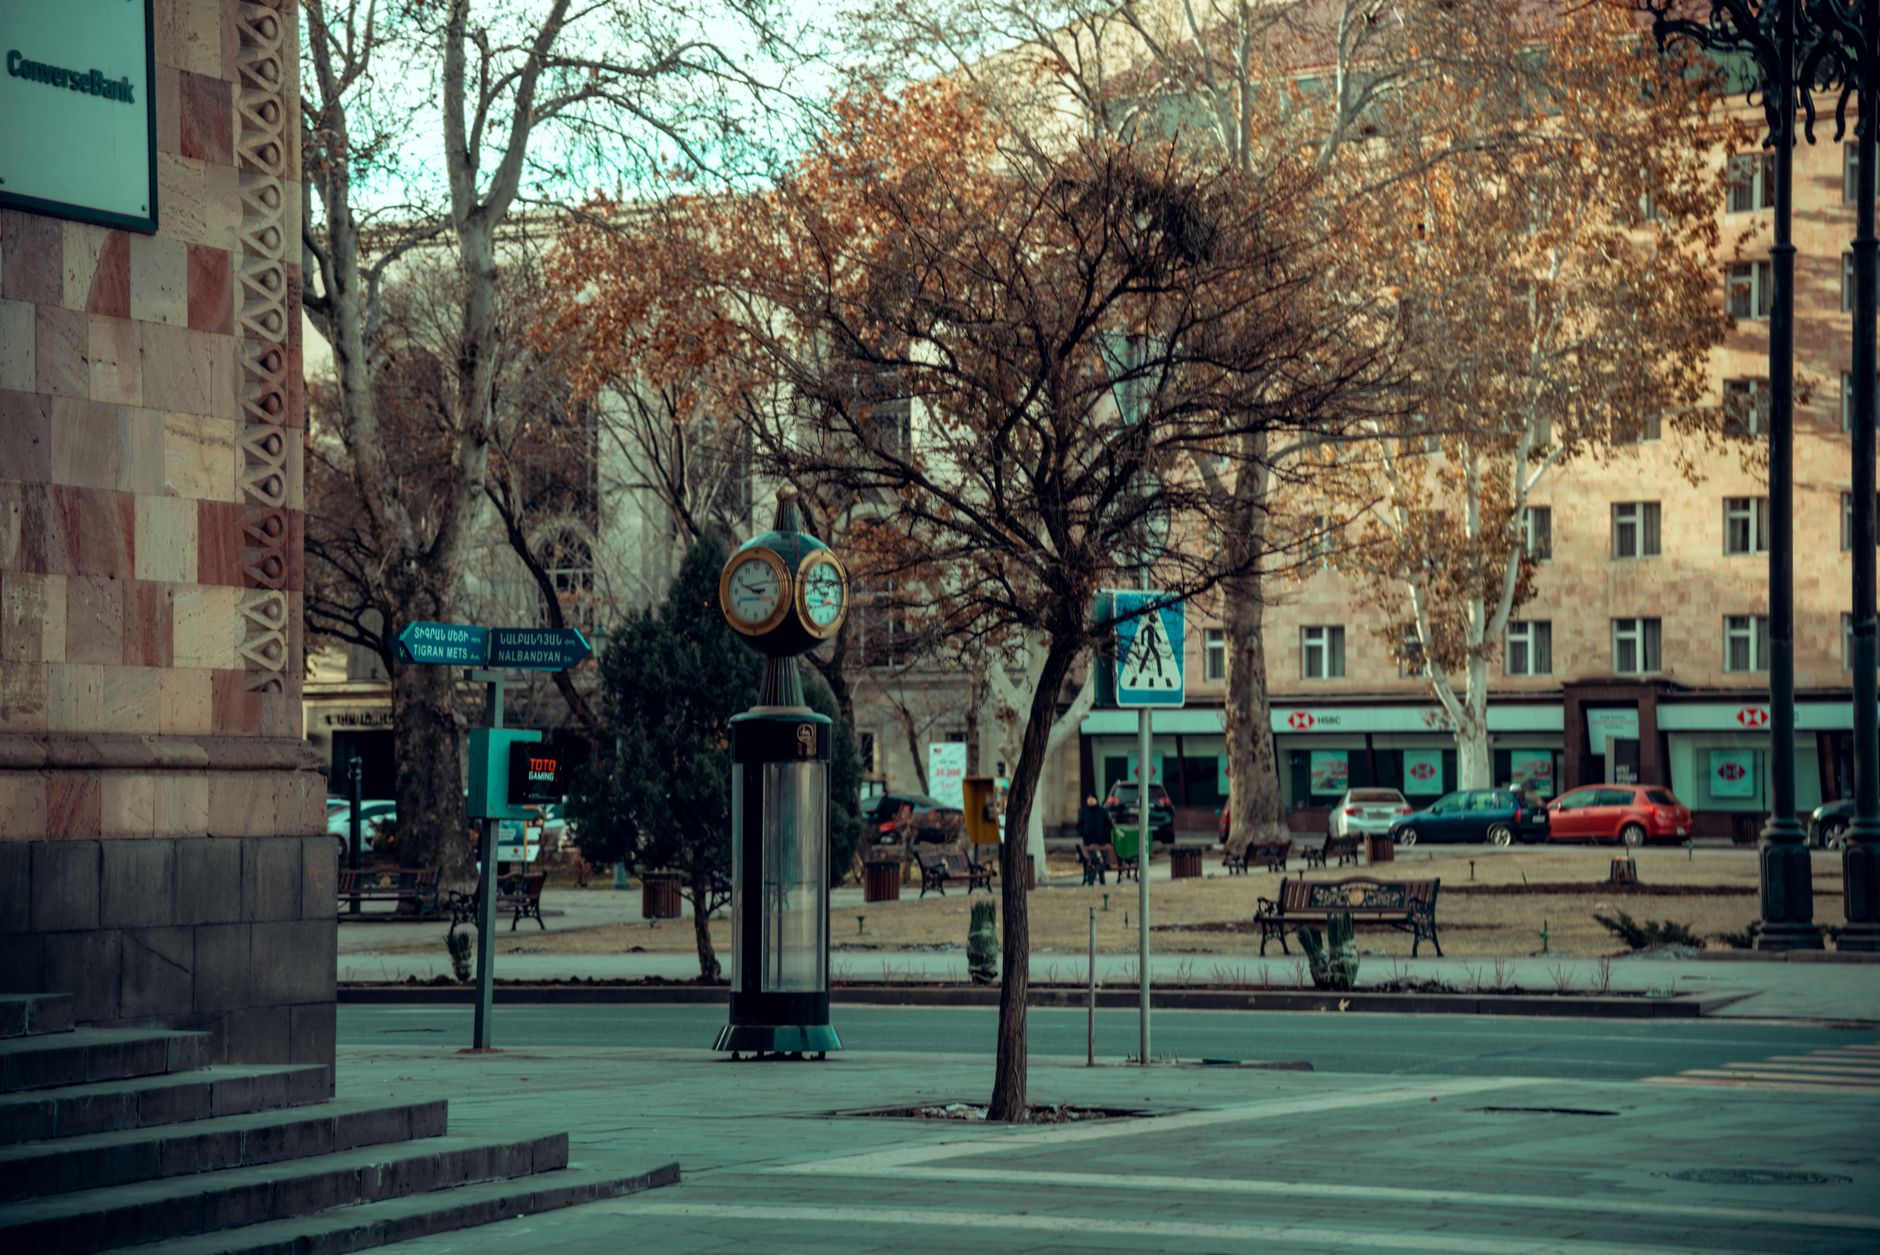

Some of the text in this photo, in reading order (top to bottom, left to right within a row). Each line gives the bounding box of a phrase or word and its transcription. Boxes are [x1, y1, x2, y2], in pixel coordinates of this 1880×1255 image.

[7, 49, 135, 105] ConverseBank
[415, 627, 446, 641] ՏԻԳՐԱՆ
[447, 629, 469, 643] ՄԵԾԻ
[500, 632, 562, 646] ՆԱԼԲԱՆԴՅԱՆ
[413, 644, 444, 657] TIGRAN
[446, 647, 468, 660] METS
[498, 650, 561, 662] NALBANDYAN
[1317, 715, 1341, 725] HSBC
[529, 758, 556, 771] TOTO
[528, 771, 554, 781] GAMING
